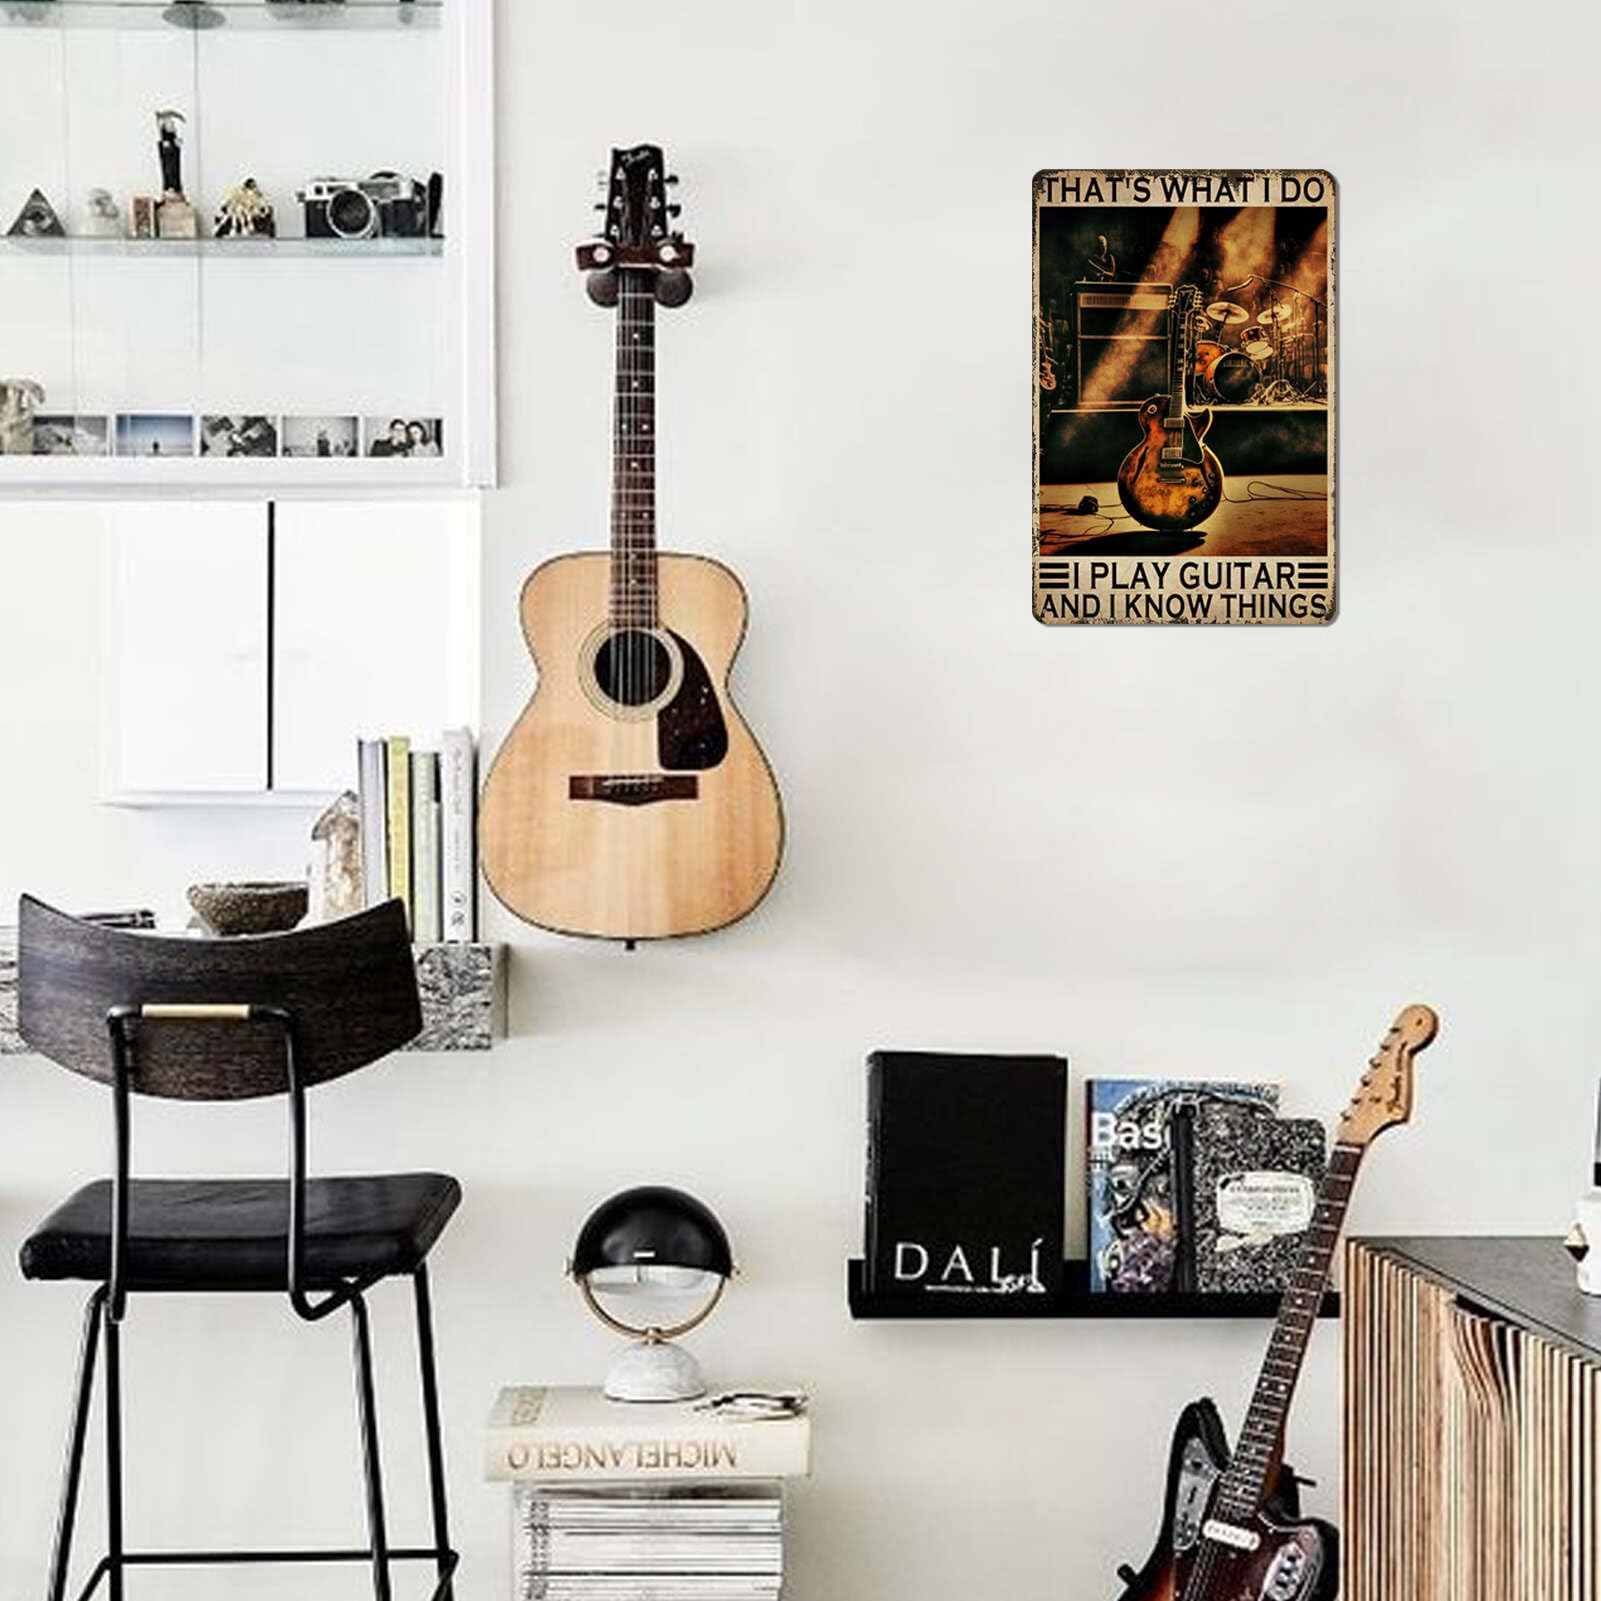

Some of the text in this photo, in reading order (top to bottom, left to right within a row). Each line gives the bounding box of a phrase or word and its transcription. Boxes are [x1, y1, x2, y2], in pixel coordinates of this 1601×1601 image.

[1043, 176, 1325, 203] THAT'S WHAT I DO
[1073, 561, 1296, 590] I PLAY GUITAR
[1040, 593, 1327, 619] AND I KNOW THINGS
[894, 1237, 1045, 1283] DALÍ
[507, 1440, 738, 1470] MICHELANGELO
